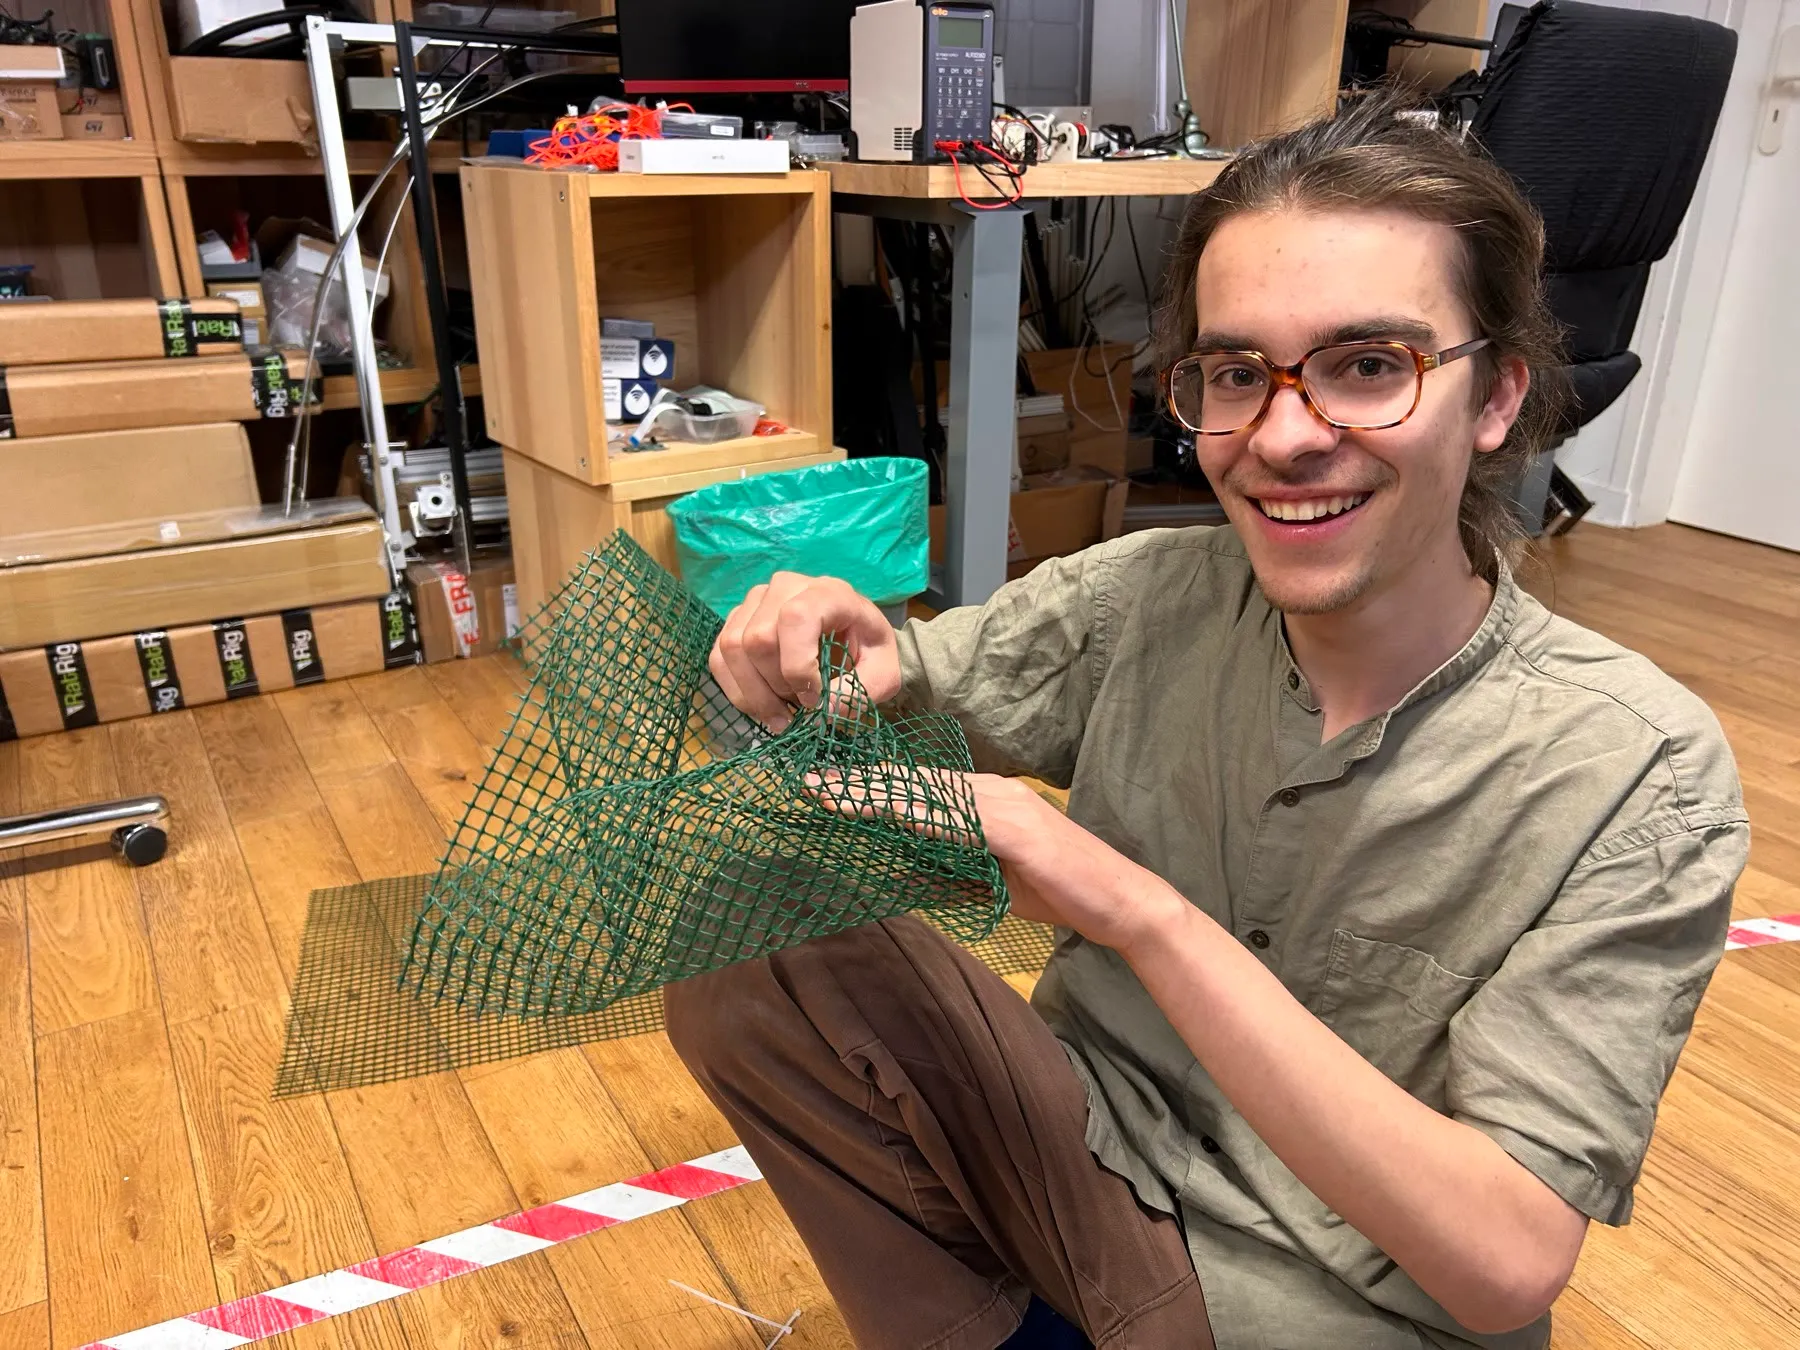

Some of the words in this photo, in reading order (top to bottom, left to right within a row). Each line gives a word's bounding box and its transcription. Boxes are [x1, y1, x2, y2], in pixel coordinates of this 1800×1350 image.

[263, 356, 289, 418] RatRig
[384, 592, 405, 641] RatR
[53, 643, 84, 708] RatRig
[138, 631, 169, 681] RatR
